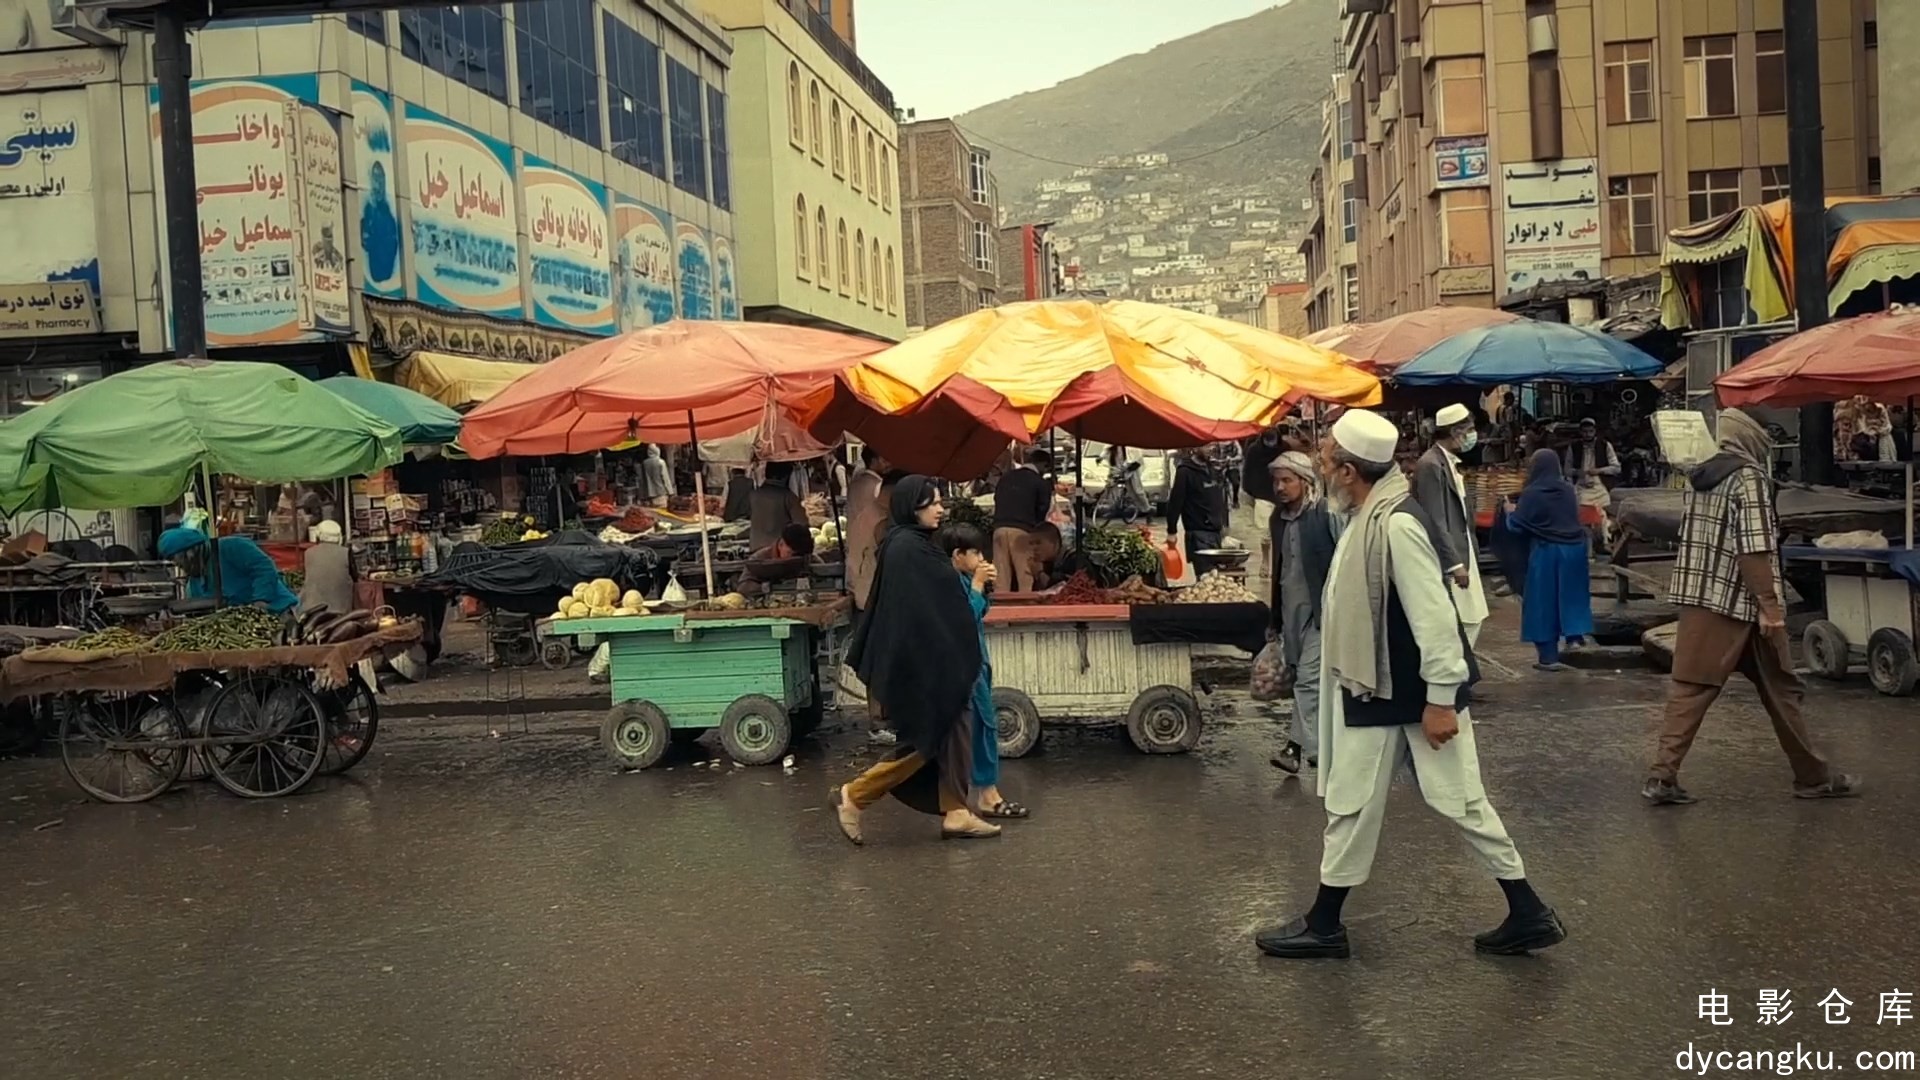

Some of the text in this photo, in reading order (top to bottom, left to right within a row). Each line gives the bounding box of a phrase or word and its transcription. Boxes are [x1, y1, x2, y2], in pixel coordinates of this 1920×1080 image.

[419, 151, 506, 219] اسماعیل خیل
[1507, 188, 1595, 209] شفا
[234, 214, 292, 252] سماعیل
[531, 194, 567, 249] یونانی
[568, 205, 603, 259] دواخانه
[1568, 218, 1598, 240] طبی
[35, 319, 91, 329] Pharmacy
